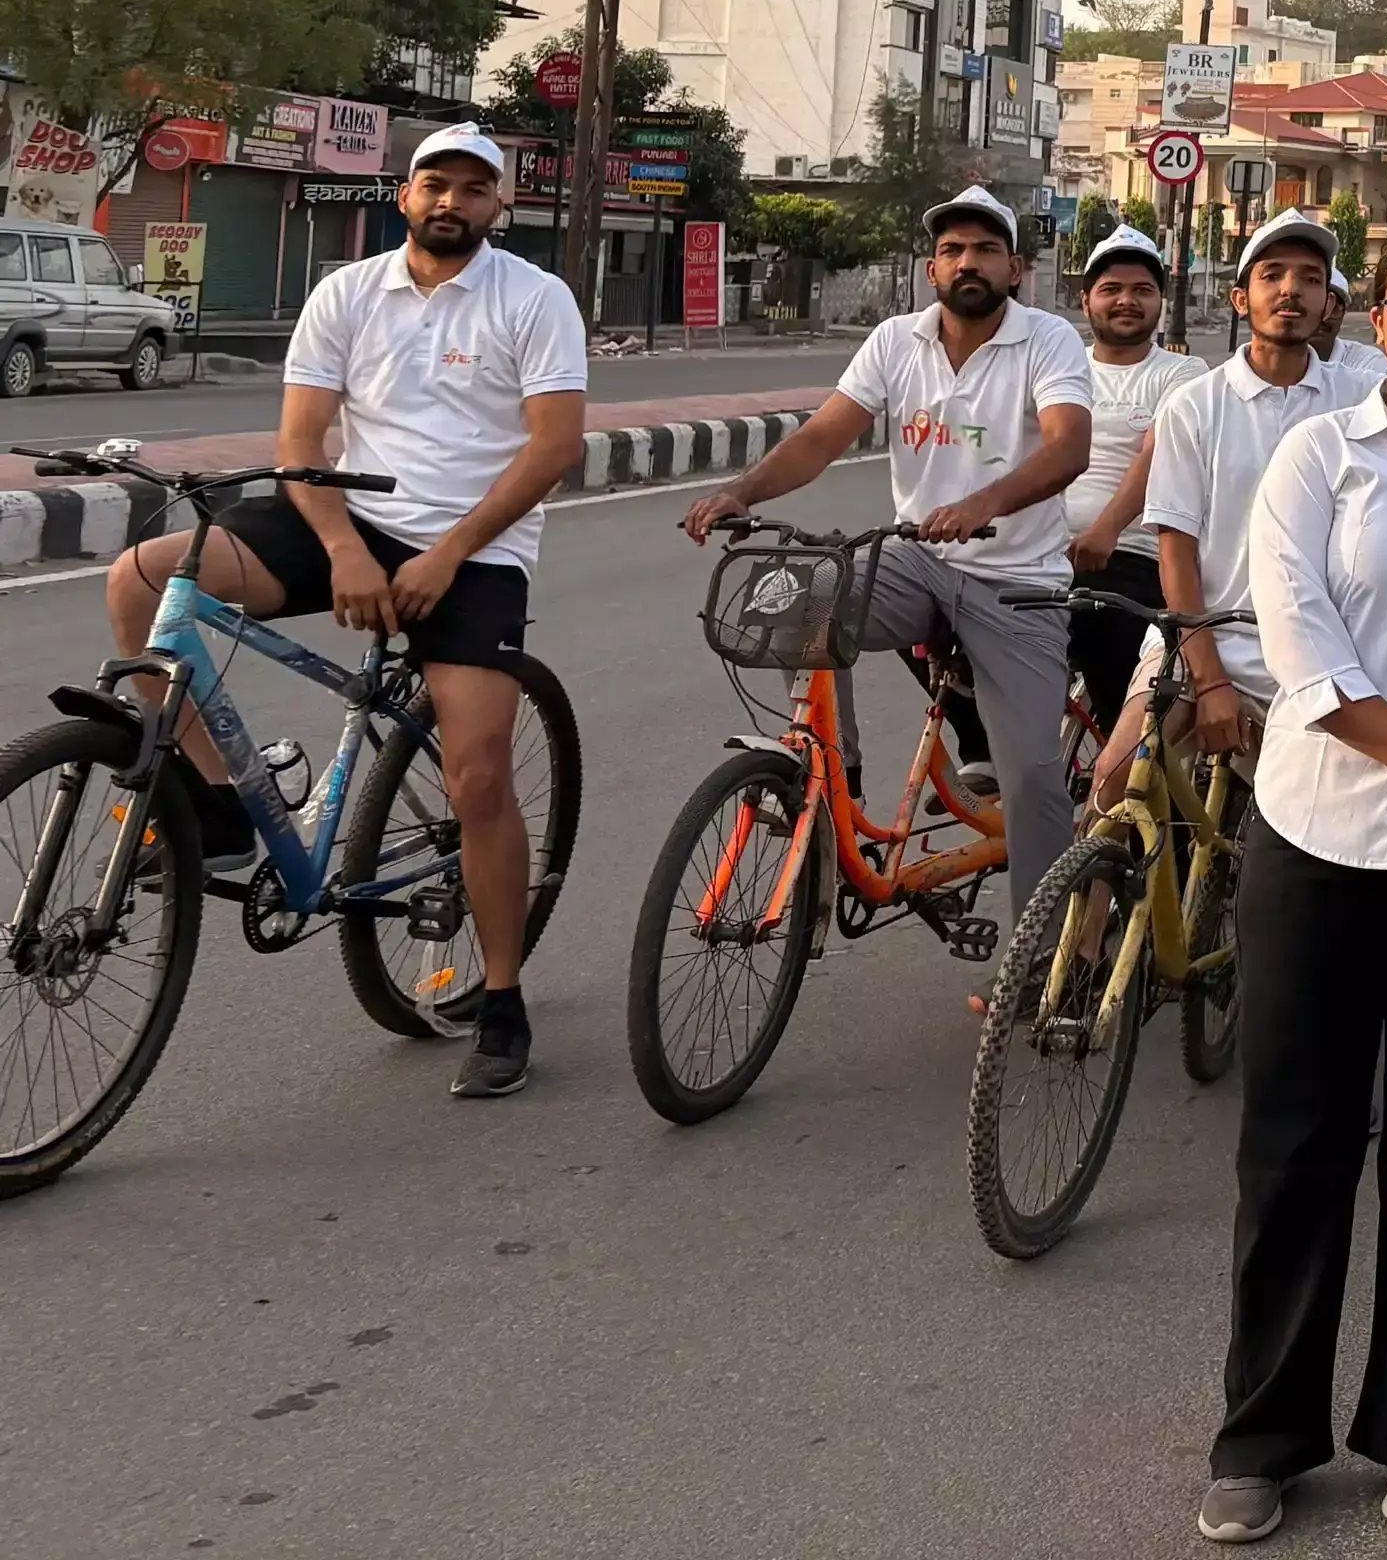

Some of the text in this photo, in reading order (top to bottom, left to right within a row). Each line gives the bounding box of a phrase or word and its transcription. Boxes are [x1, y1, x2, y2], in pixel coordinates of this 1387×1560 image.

[1188, 53, 1213, 69] BR
[1167, 65, 1231, 79] JEWELLERS
[273, 104, 316, 130] CREATIONS
[332, 104, 379, 135] KAIZEN
[636, 134, 684, 145] FAST FOOD
[16, 143, 98, 175] SHOP
[641, 149, 678, 159] PUNJABI
[1158, 145, 1191, 169] 20
[640, 166, 676, 177] CHINESE
[149, 225, 203, 239] SCOOBY
[159, 240, 190, 253] DOO
